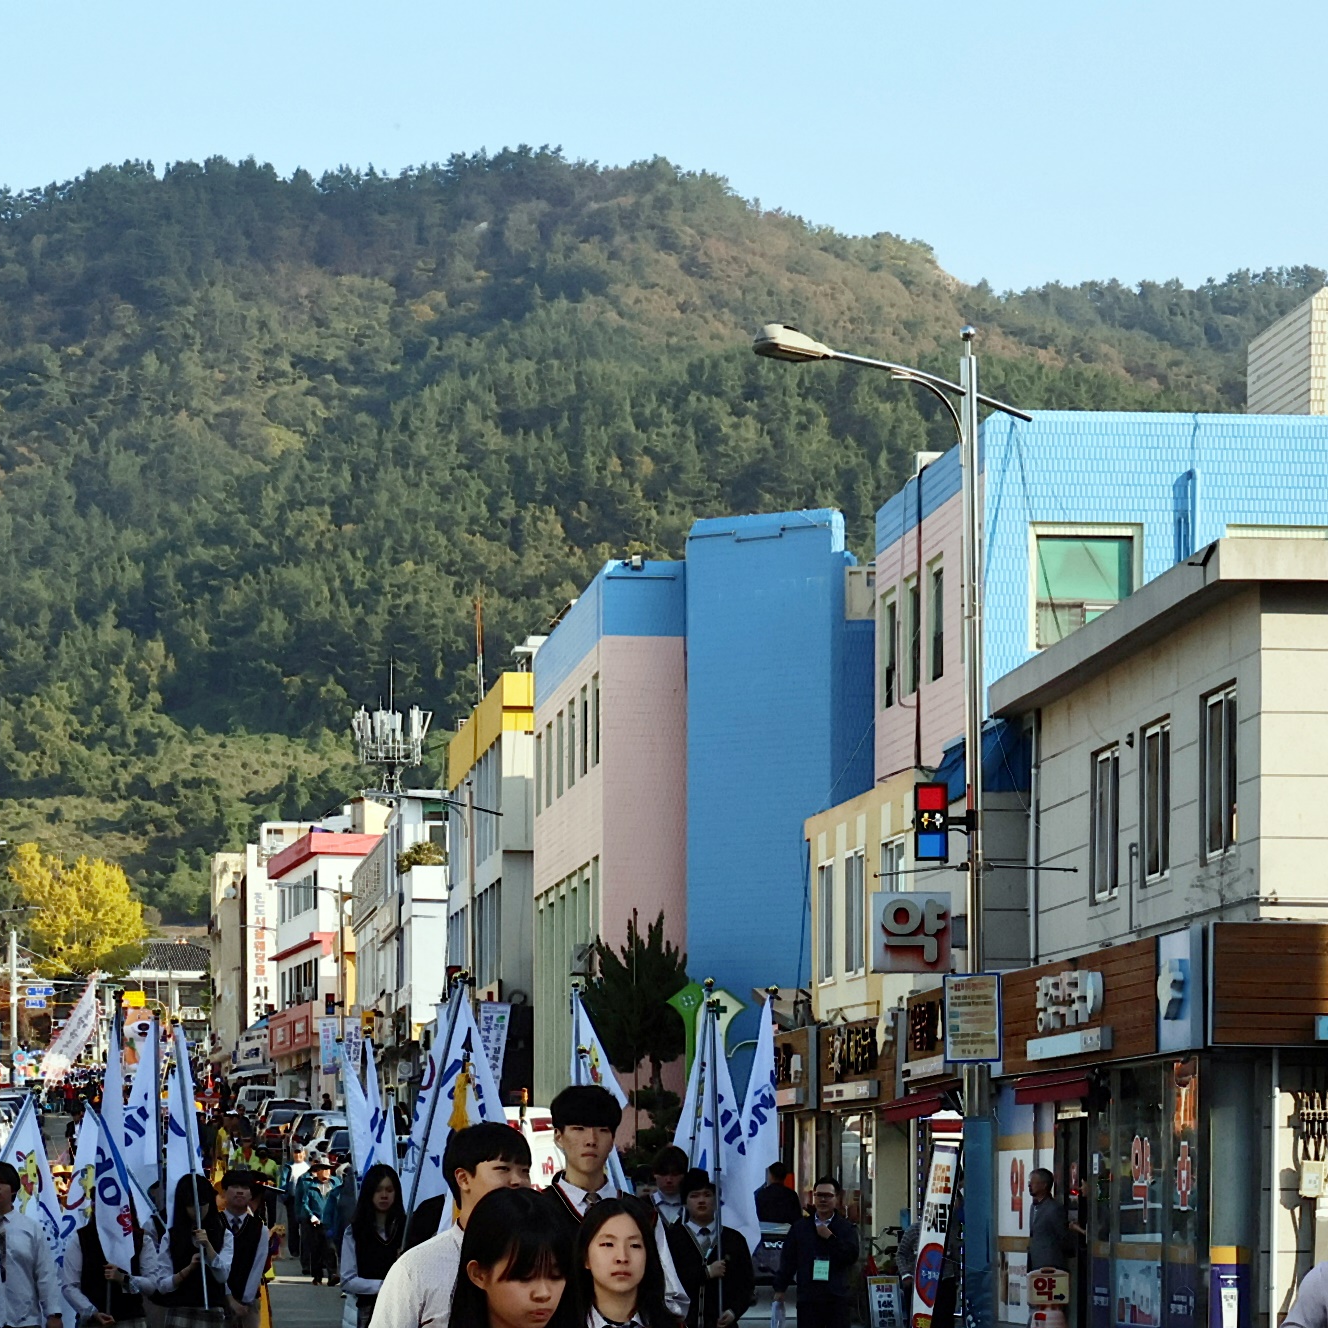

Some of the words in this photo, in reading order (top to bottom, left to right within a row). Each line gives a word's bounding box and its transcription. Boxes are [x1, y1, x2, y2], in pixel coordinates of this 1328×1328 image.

[881, 897, 947, 963] 약
[1131, 1135, 1151, 1224] 약
[1033, 1277, 1057, 1301] 약
